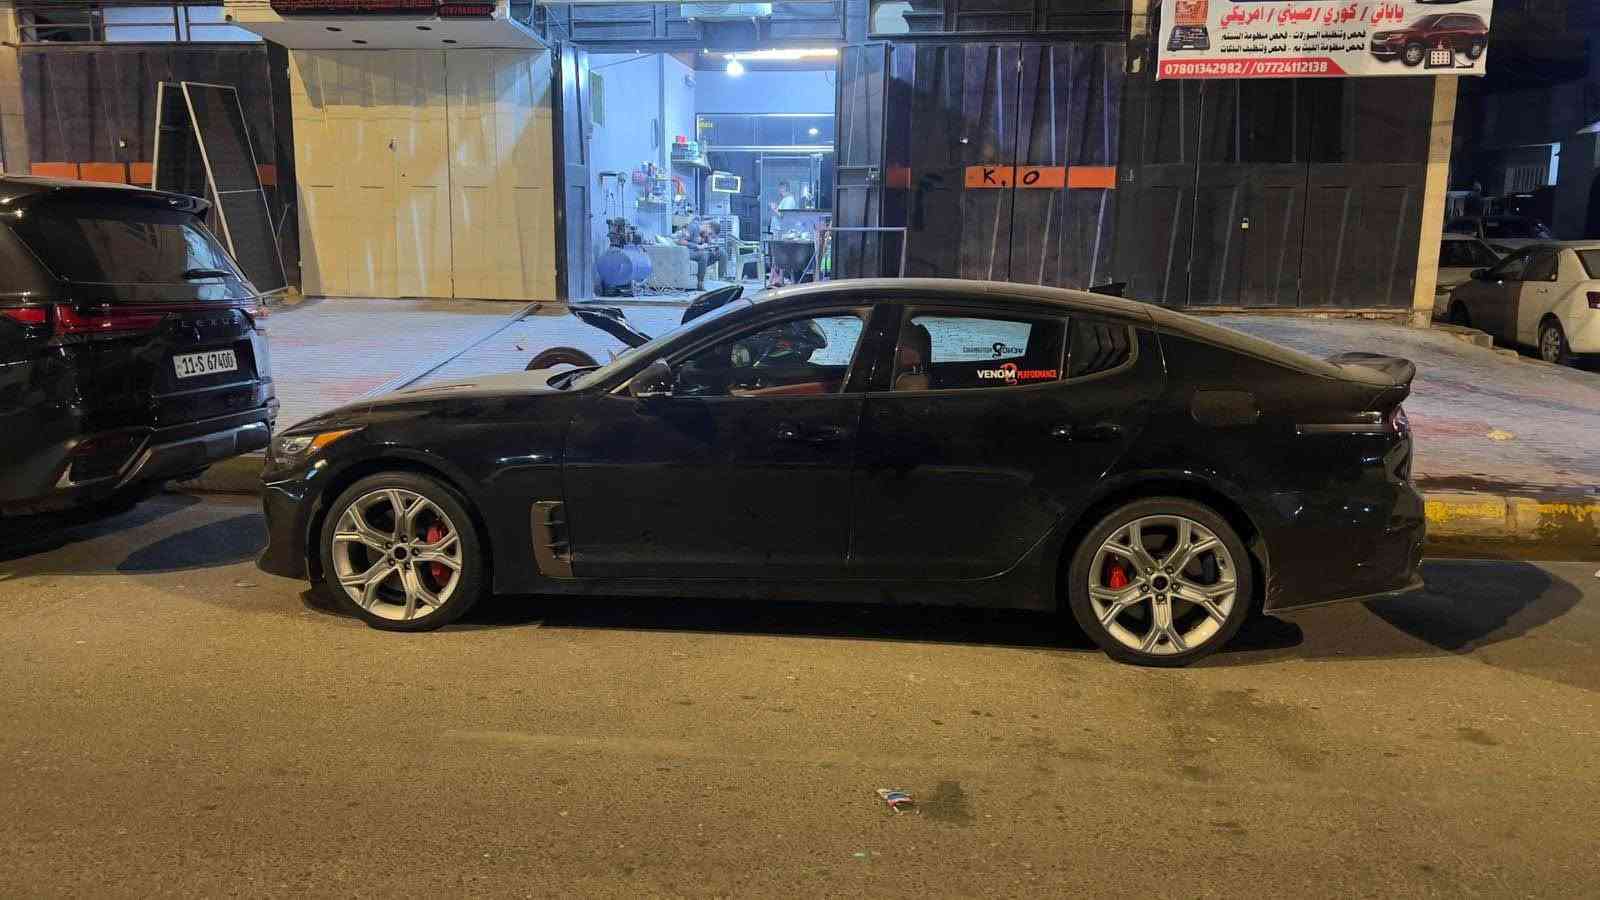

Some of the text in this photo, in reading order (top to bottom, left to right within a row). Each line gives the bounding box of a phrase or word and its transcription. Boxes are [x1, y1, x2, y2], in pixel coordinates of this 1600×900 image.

[1277, 4, 1313, 26] صيني
[1322, 3, 1358, 25] كوري
[1269, 31, 1287, 41] فحص
[1347, 30, 1366, 40] فحص
[1268, 43, 1286, 53] فحص
[1346, 42, 1364, 52] فحص
[977, 369, 1015, 379] VENOM
